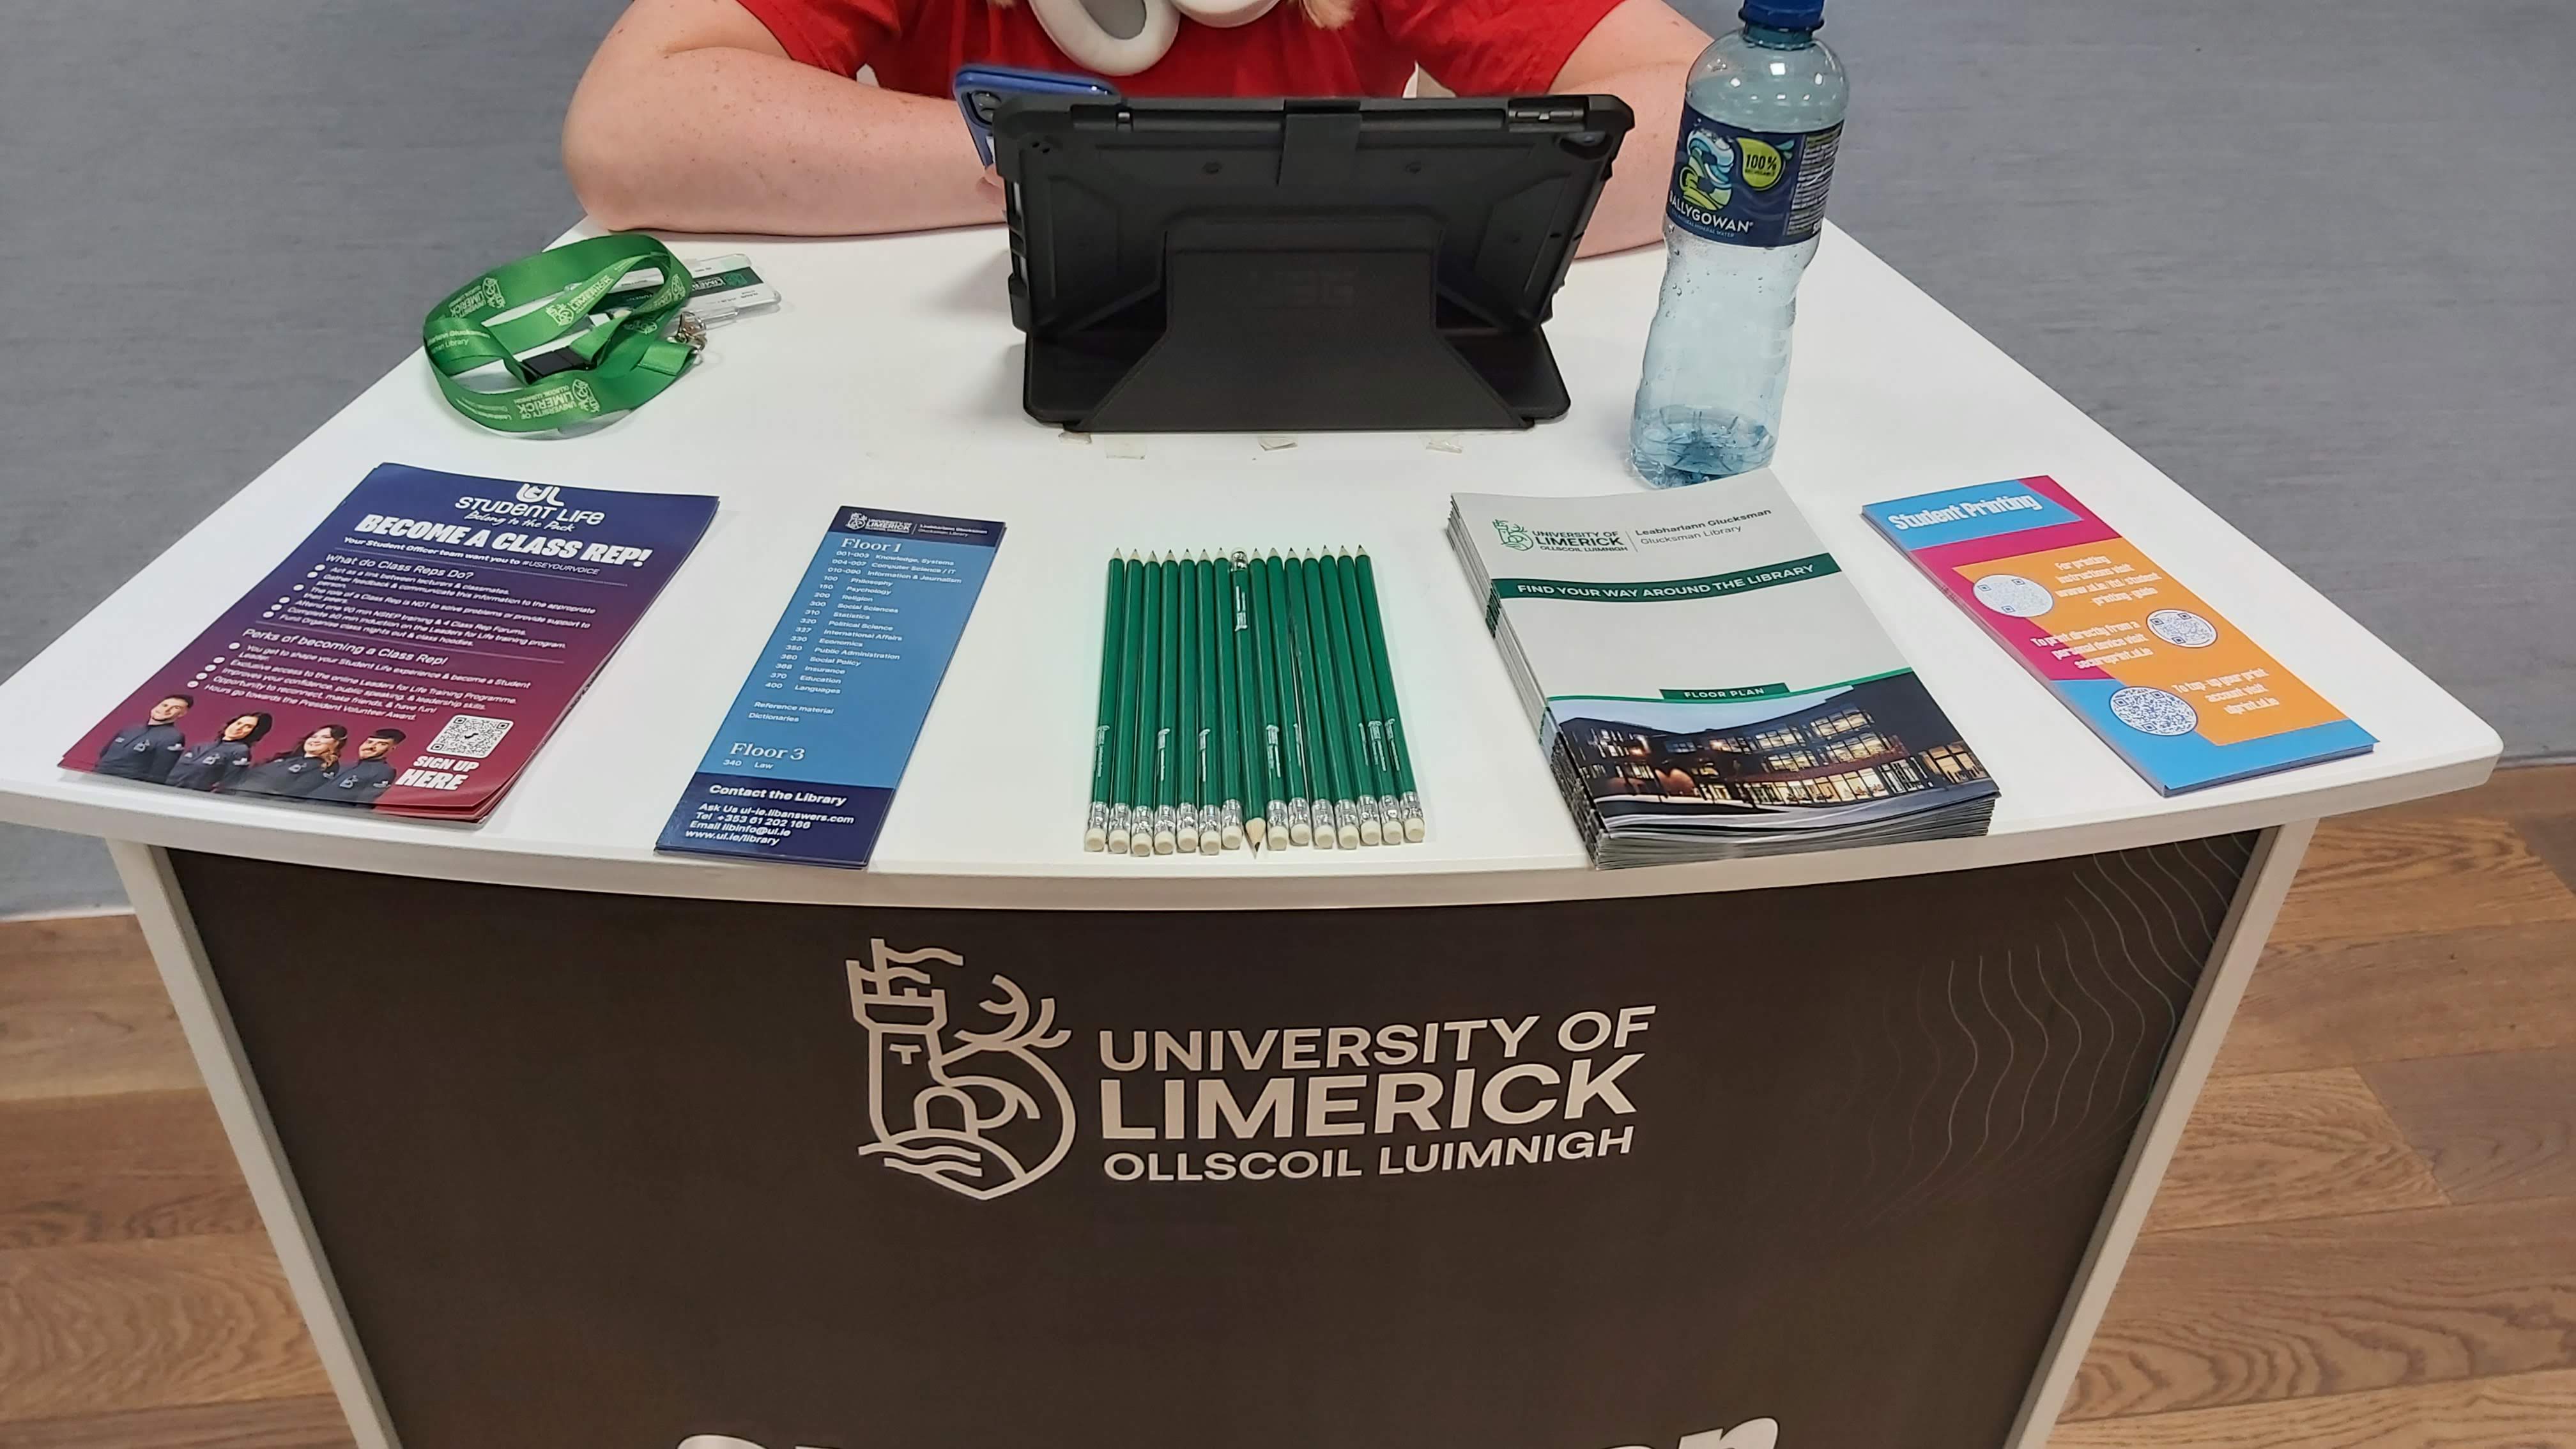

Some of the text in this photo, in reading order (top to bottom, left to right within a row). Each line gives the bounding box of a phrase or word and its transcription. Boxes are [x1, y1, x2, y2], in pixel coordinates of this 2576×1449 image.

[1746, 154, 1777, 171] 100%
[516, 391, 574, 414] LIMERICK
[1888, 493, 2044, 530] Student Printing
[464, 510, 506, 525] Belong
[544, 521, 574, 531] Pack
[1636, 510, 1771, 537] Leabharlann Glucksman
[355, 514, 652, 566] BECOME A CLASS REP!
[1535, 537, 1623, 547] LIMERICK
[1639, 525, 1740, 544] Glucksman Library
[365, 540, 405, 549] Student
[841, 538, 891, 551] Floor
[326, 554, 357, 564] What
[378, 561, 411, 571] Class
[413, 565, 445, 575] Reps
[447, 570, 473, 579] Do?
[2071, 556, 2111, 569] printing
[1557, 587, 1600, 596] YOUR
[1643, 585, 1712, 598] AROUND
[1712, 579, 1745, 590] THE
[1747, 564, 1815, 585] LIBRARY
[2056, 569, 2113, 583] instructions
[847, 586, 891, 595] Psychology
[824, 629, 874, 638] International
[2044, 633, 2071, 645] print
[2069, 627, 2110, 639] directly
[2105, 623, 2133, 632] from
[242, 629, 279, 640] Perks
[297, 636, 364, 654] becoming
[378, 648, 414, 660] Class
[2051, 643, 2096, 659] personal
[2094, 638, 2126, 649] device
[841, 650, 899, 659] Administration
[795, 685, 840, 693] Languages
[1729, 687, 1765, 698] PLAN
[204, 684, 231, 693] Hours
[245, 691, 281, 701] towards
[298, 700, 342, 710] President
[343, 706, 386, 715] Volunteer
[754, 702, 797, 710] Reference
[748, 712, 798, 721] Dictionaries
[730, 743, 804, 759] Floor 3
[413, 756, 479, 771] SIGN UP
[395, 769, 468, 790] HERE
[709, 785, 846, 806] Contact the Library
[740, 807, 854, 823] ul-ie.libanswers.com
[689, 820, 790, 836] Email libinfo@ul.ie
[686, 831, 779, 845] www.ul.ie/library
[1100, 1006, 1656, 1071] UNIVERSITY OF
[1101, 1053, 1645, 1140] LIMERICK
[1104, 1126, 1634, 1181] OLLSCOIL LUIMNIGH
